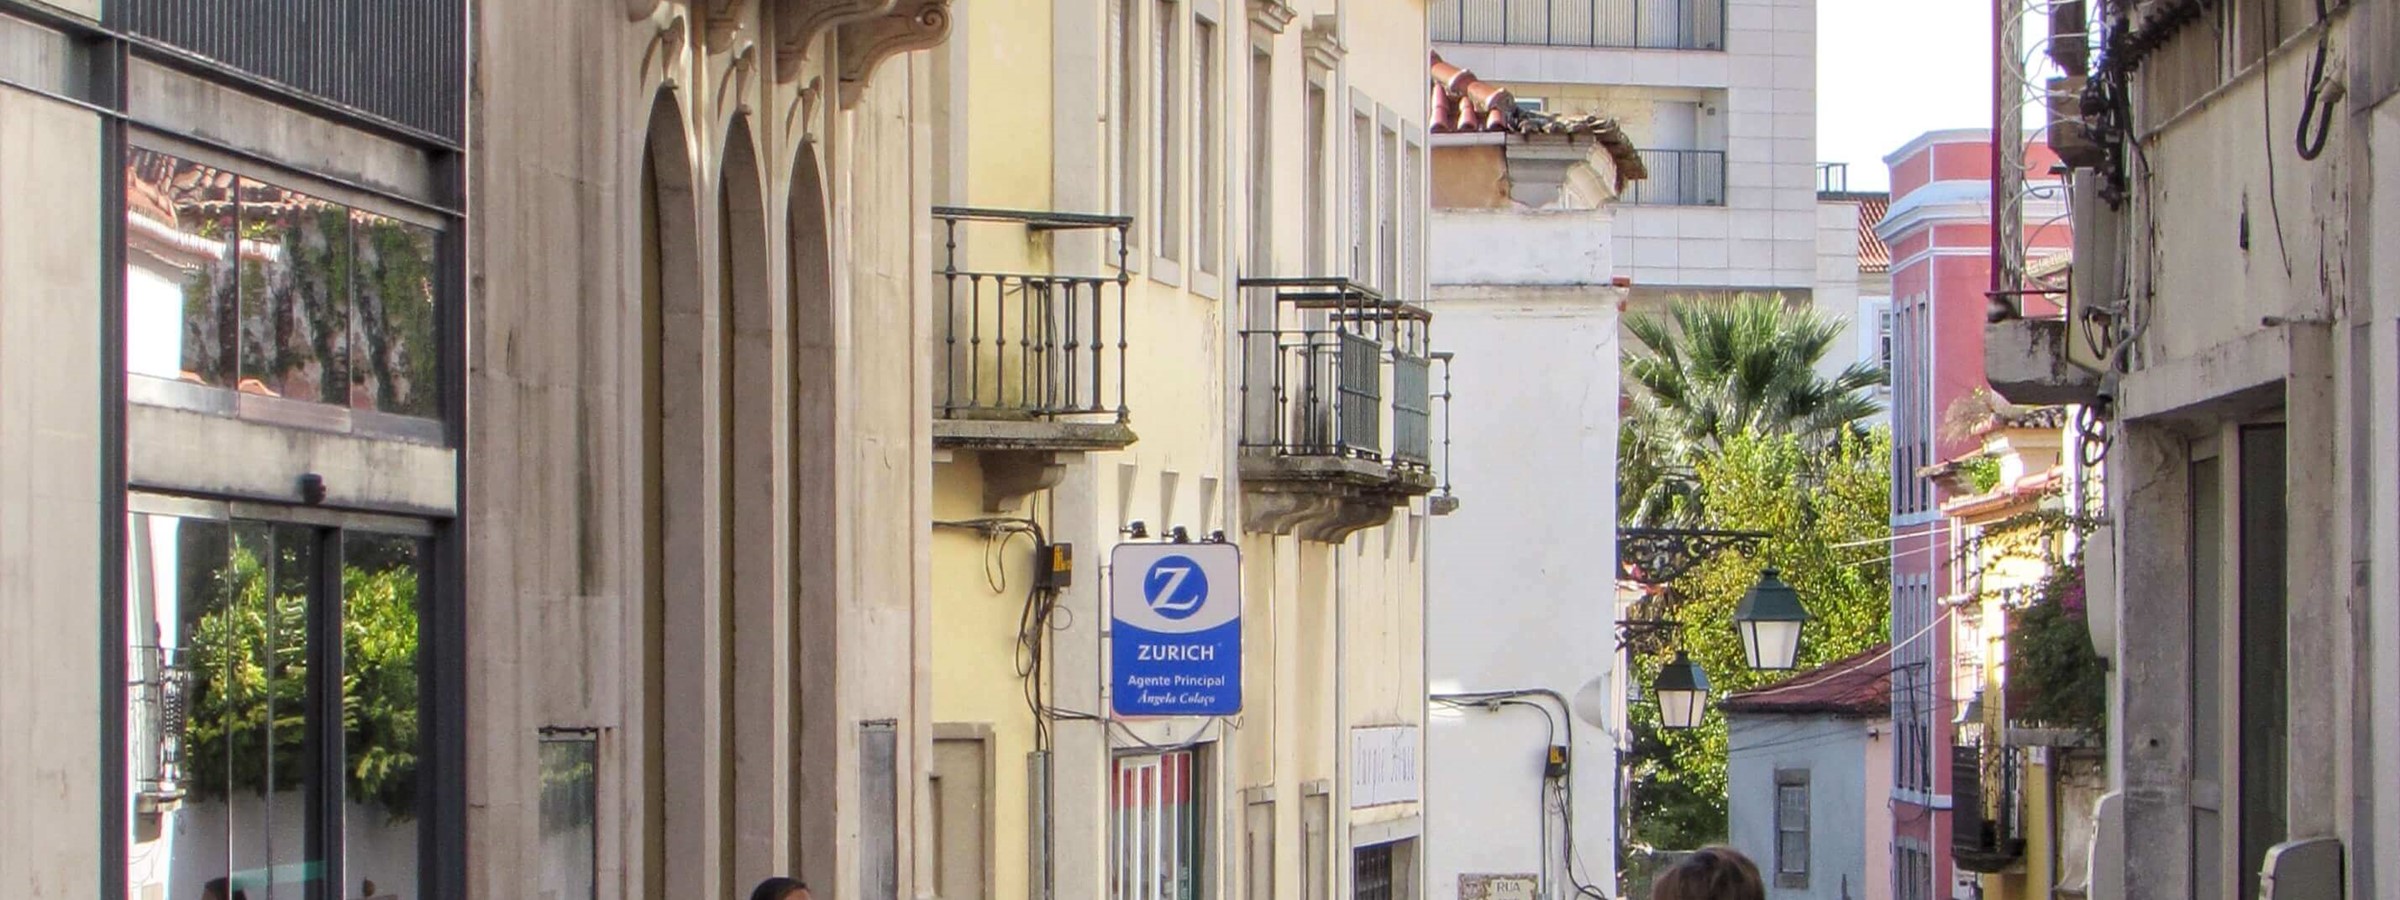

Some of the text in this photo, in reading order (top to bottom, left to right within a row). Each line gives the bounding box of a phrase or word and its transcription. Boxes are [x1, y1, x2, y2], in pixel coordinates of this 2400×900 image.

[1151, 567, 1199, 611] Z
[1138, 645, 1214, 660] ZURICH
[1127, 675, 1225, 688] Agente Principal
[1180, 692, 1216, 707] Colaço
[1496, 881, 1521, 893] RUA
